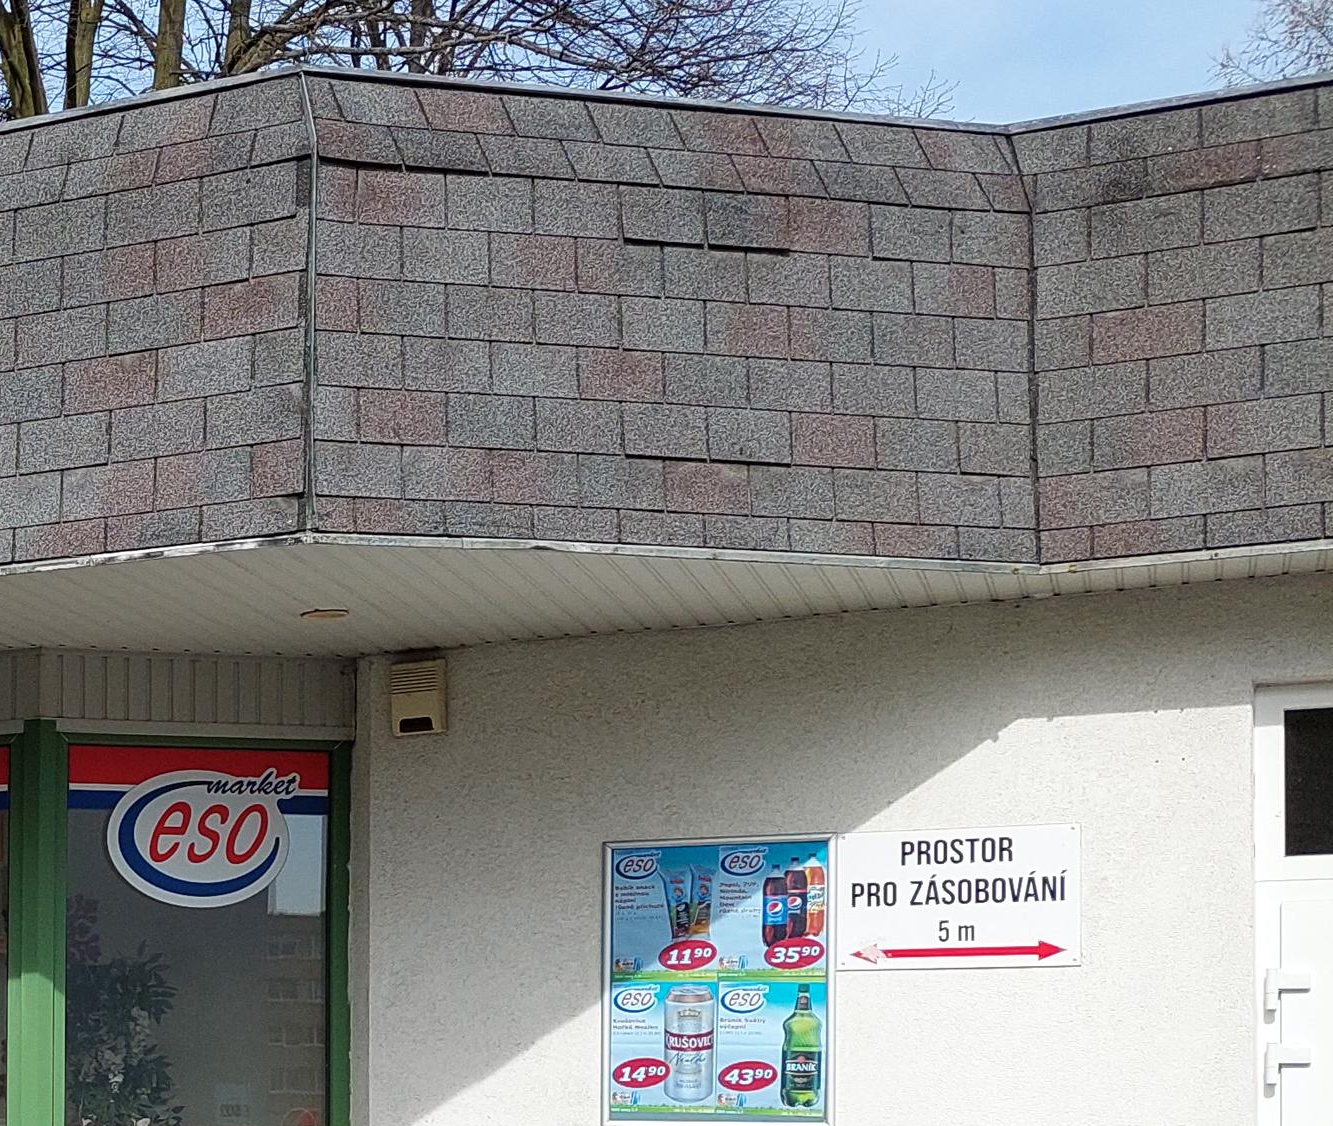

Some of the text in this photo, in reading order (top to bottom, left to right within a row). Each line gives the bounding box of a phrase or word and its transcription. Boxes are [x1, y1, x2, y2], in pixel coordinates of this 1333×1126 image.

[206, 770, 298, 795] market
[149, 801, 268, 864] eso
[901, 837, 1013, 865] PROSTOR
[623, 858, 655, 874] eso
[728, 853, 761, 870] eso
[851, 869, 1067, 907] PRO ZÁSOBOVÁNÍ
[938, 920, 975, 942] 5 m
[622, 990, 652, 1006] eso
[728, 990, 761, 1006] eso
[786, 1061, 817, 1072] BRANÍK
